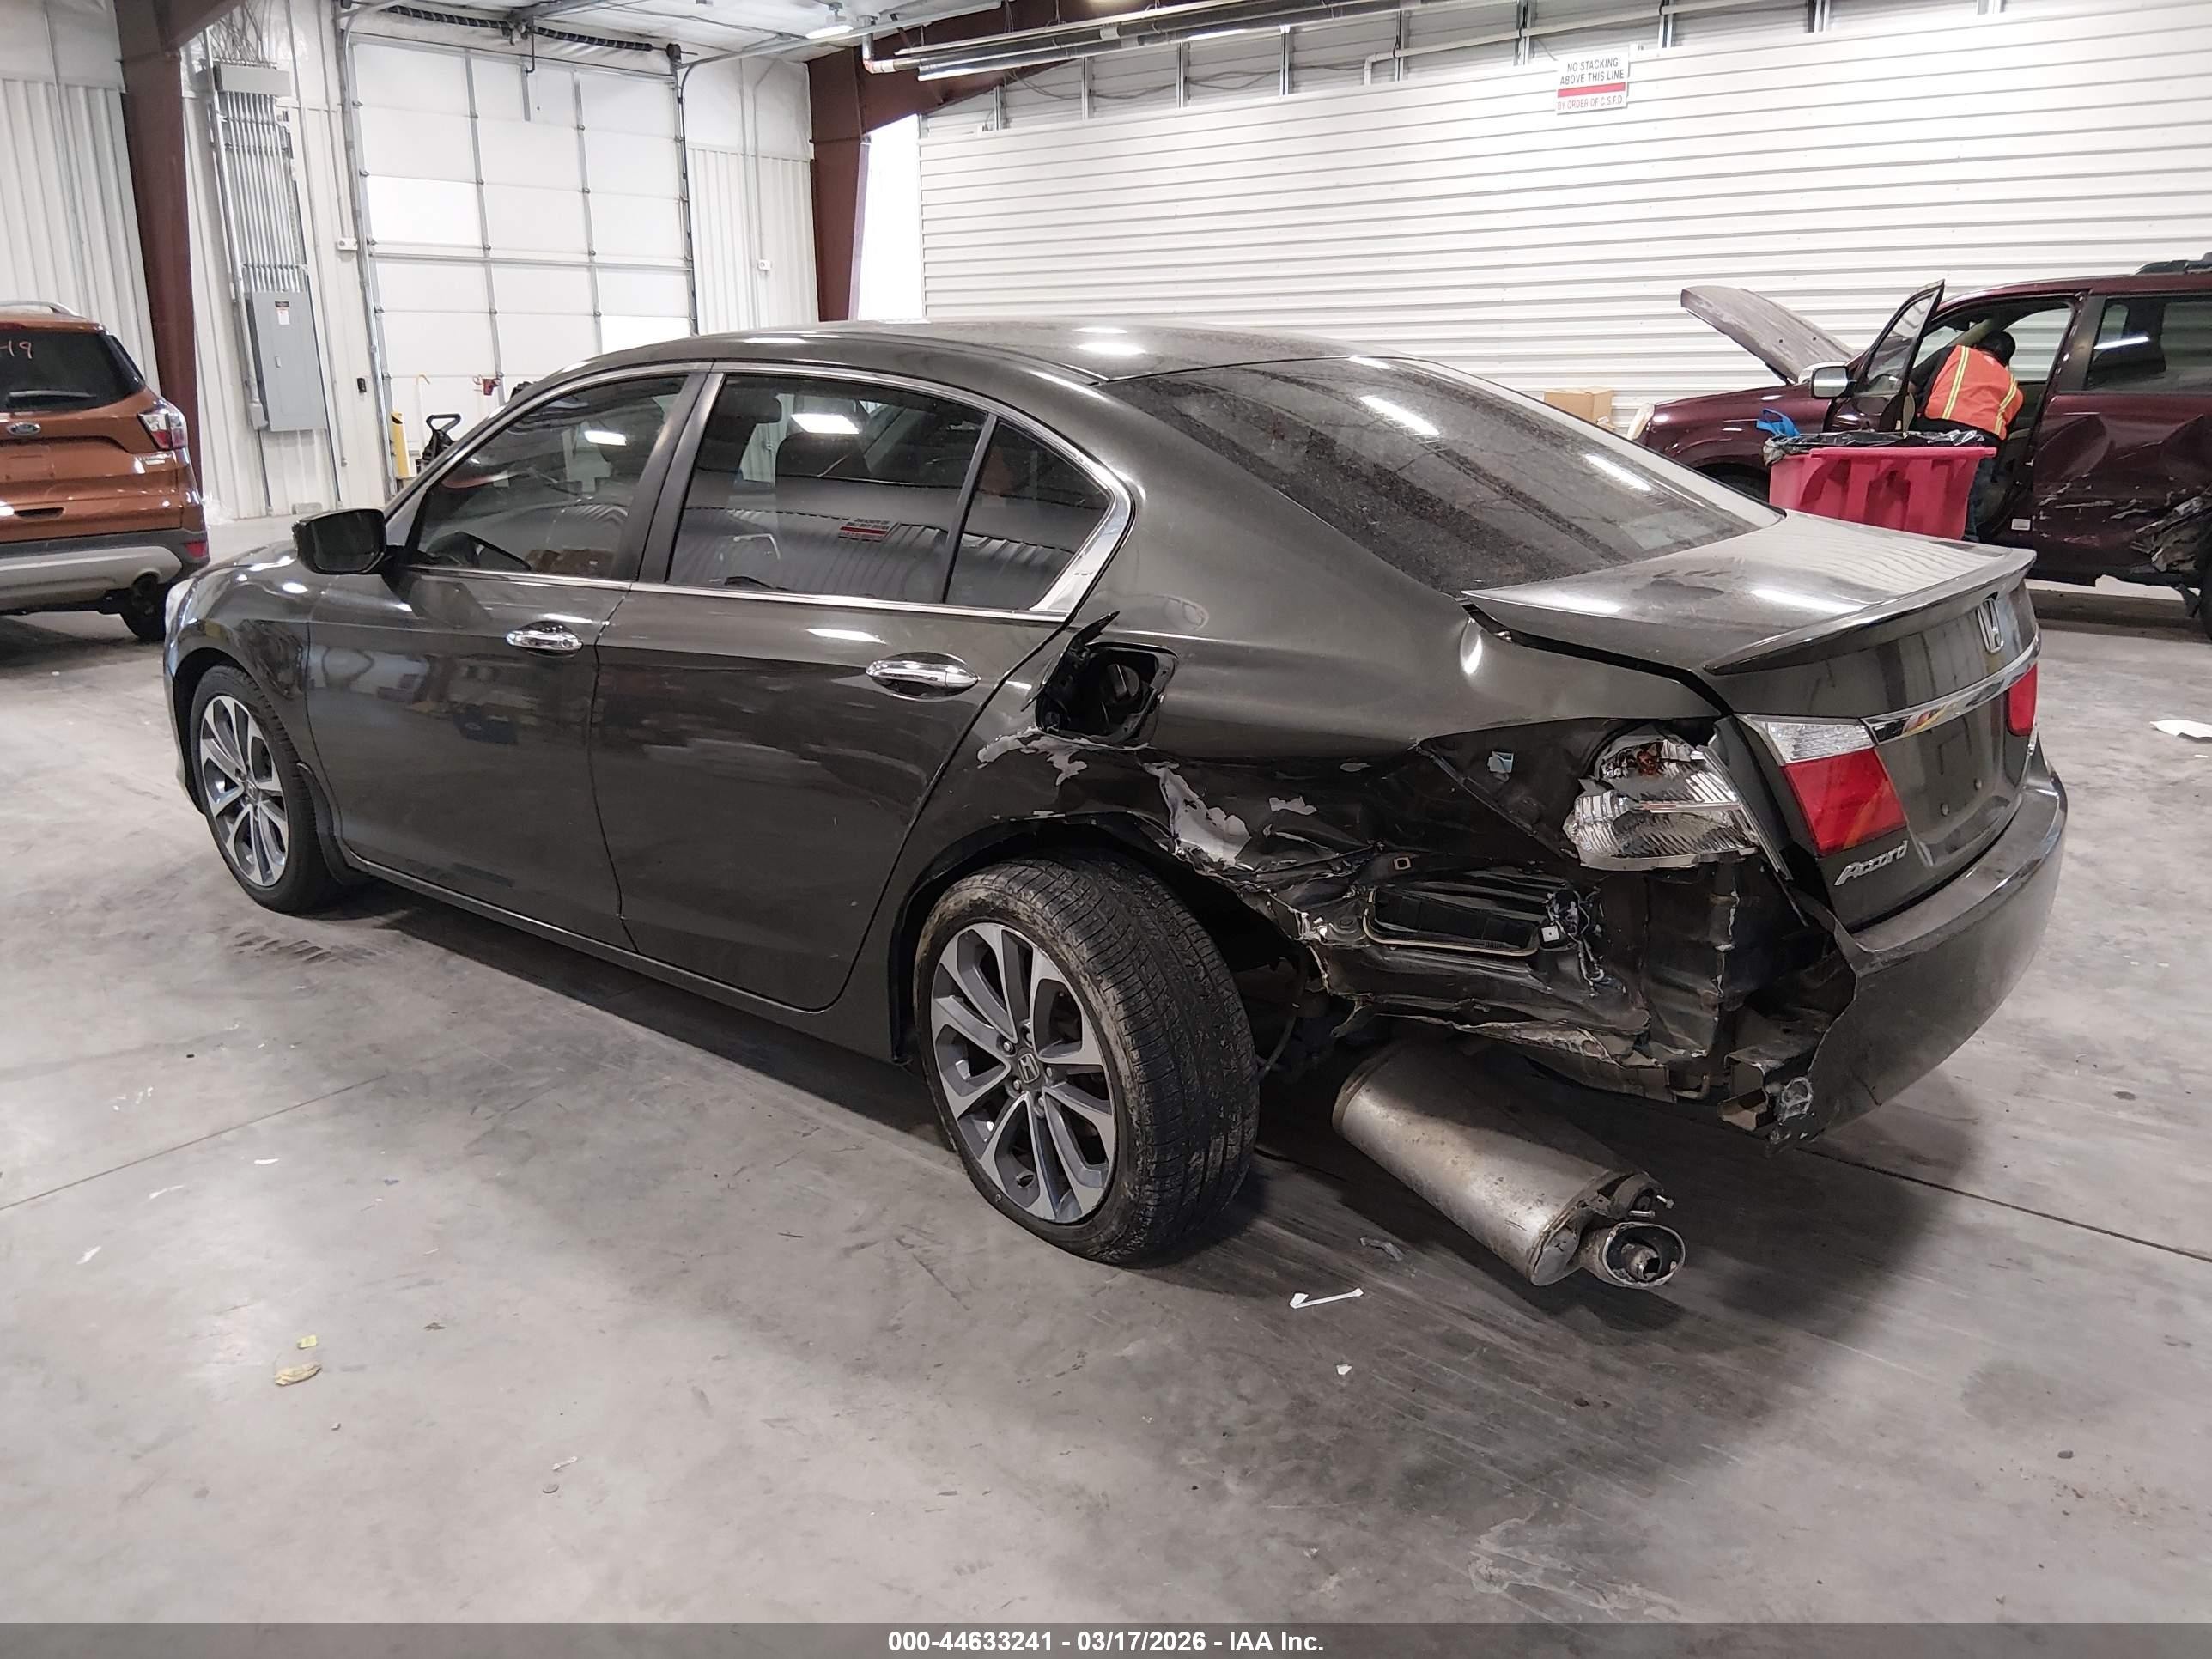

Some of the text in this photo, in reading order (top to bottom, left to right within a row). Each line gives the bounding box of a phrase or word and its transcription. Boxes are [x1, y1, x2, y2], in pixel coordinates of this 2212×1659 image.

[1567, 57, 1619, 72] NO STACKING
[1560, 70, 1624, 85] ABOVE THIS LINE
[1558, 101, 1565, 110] BY
[1567, 98, 1589, 109] ORDER
[1590, 97, 1599, 108] OF
[1833, 840, 1908, 886] Accord
